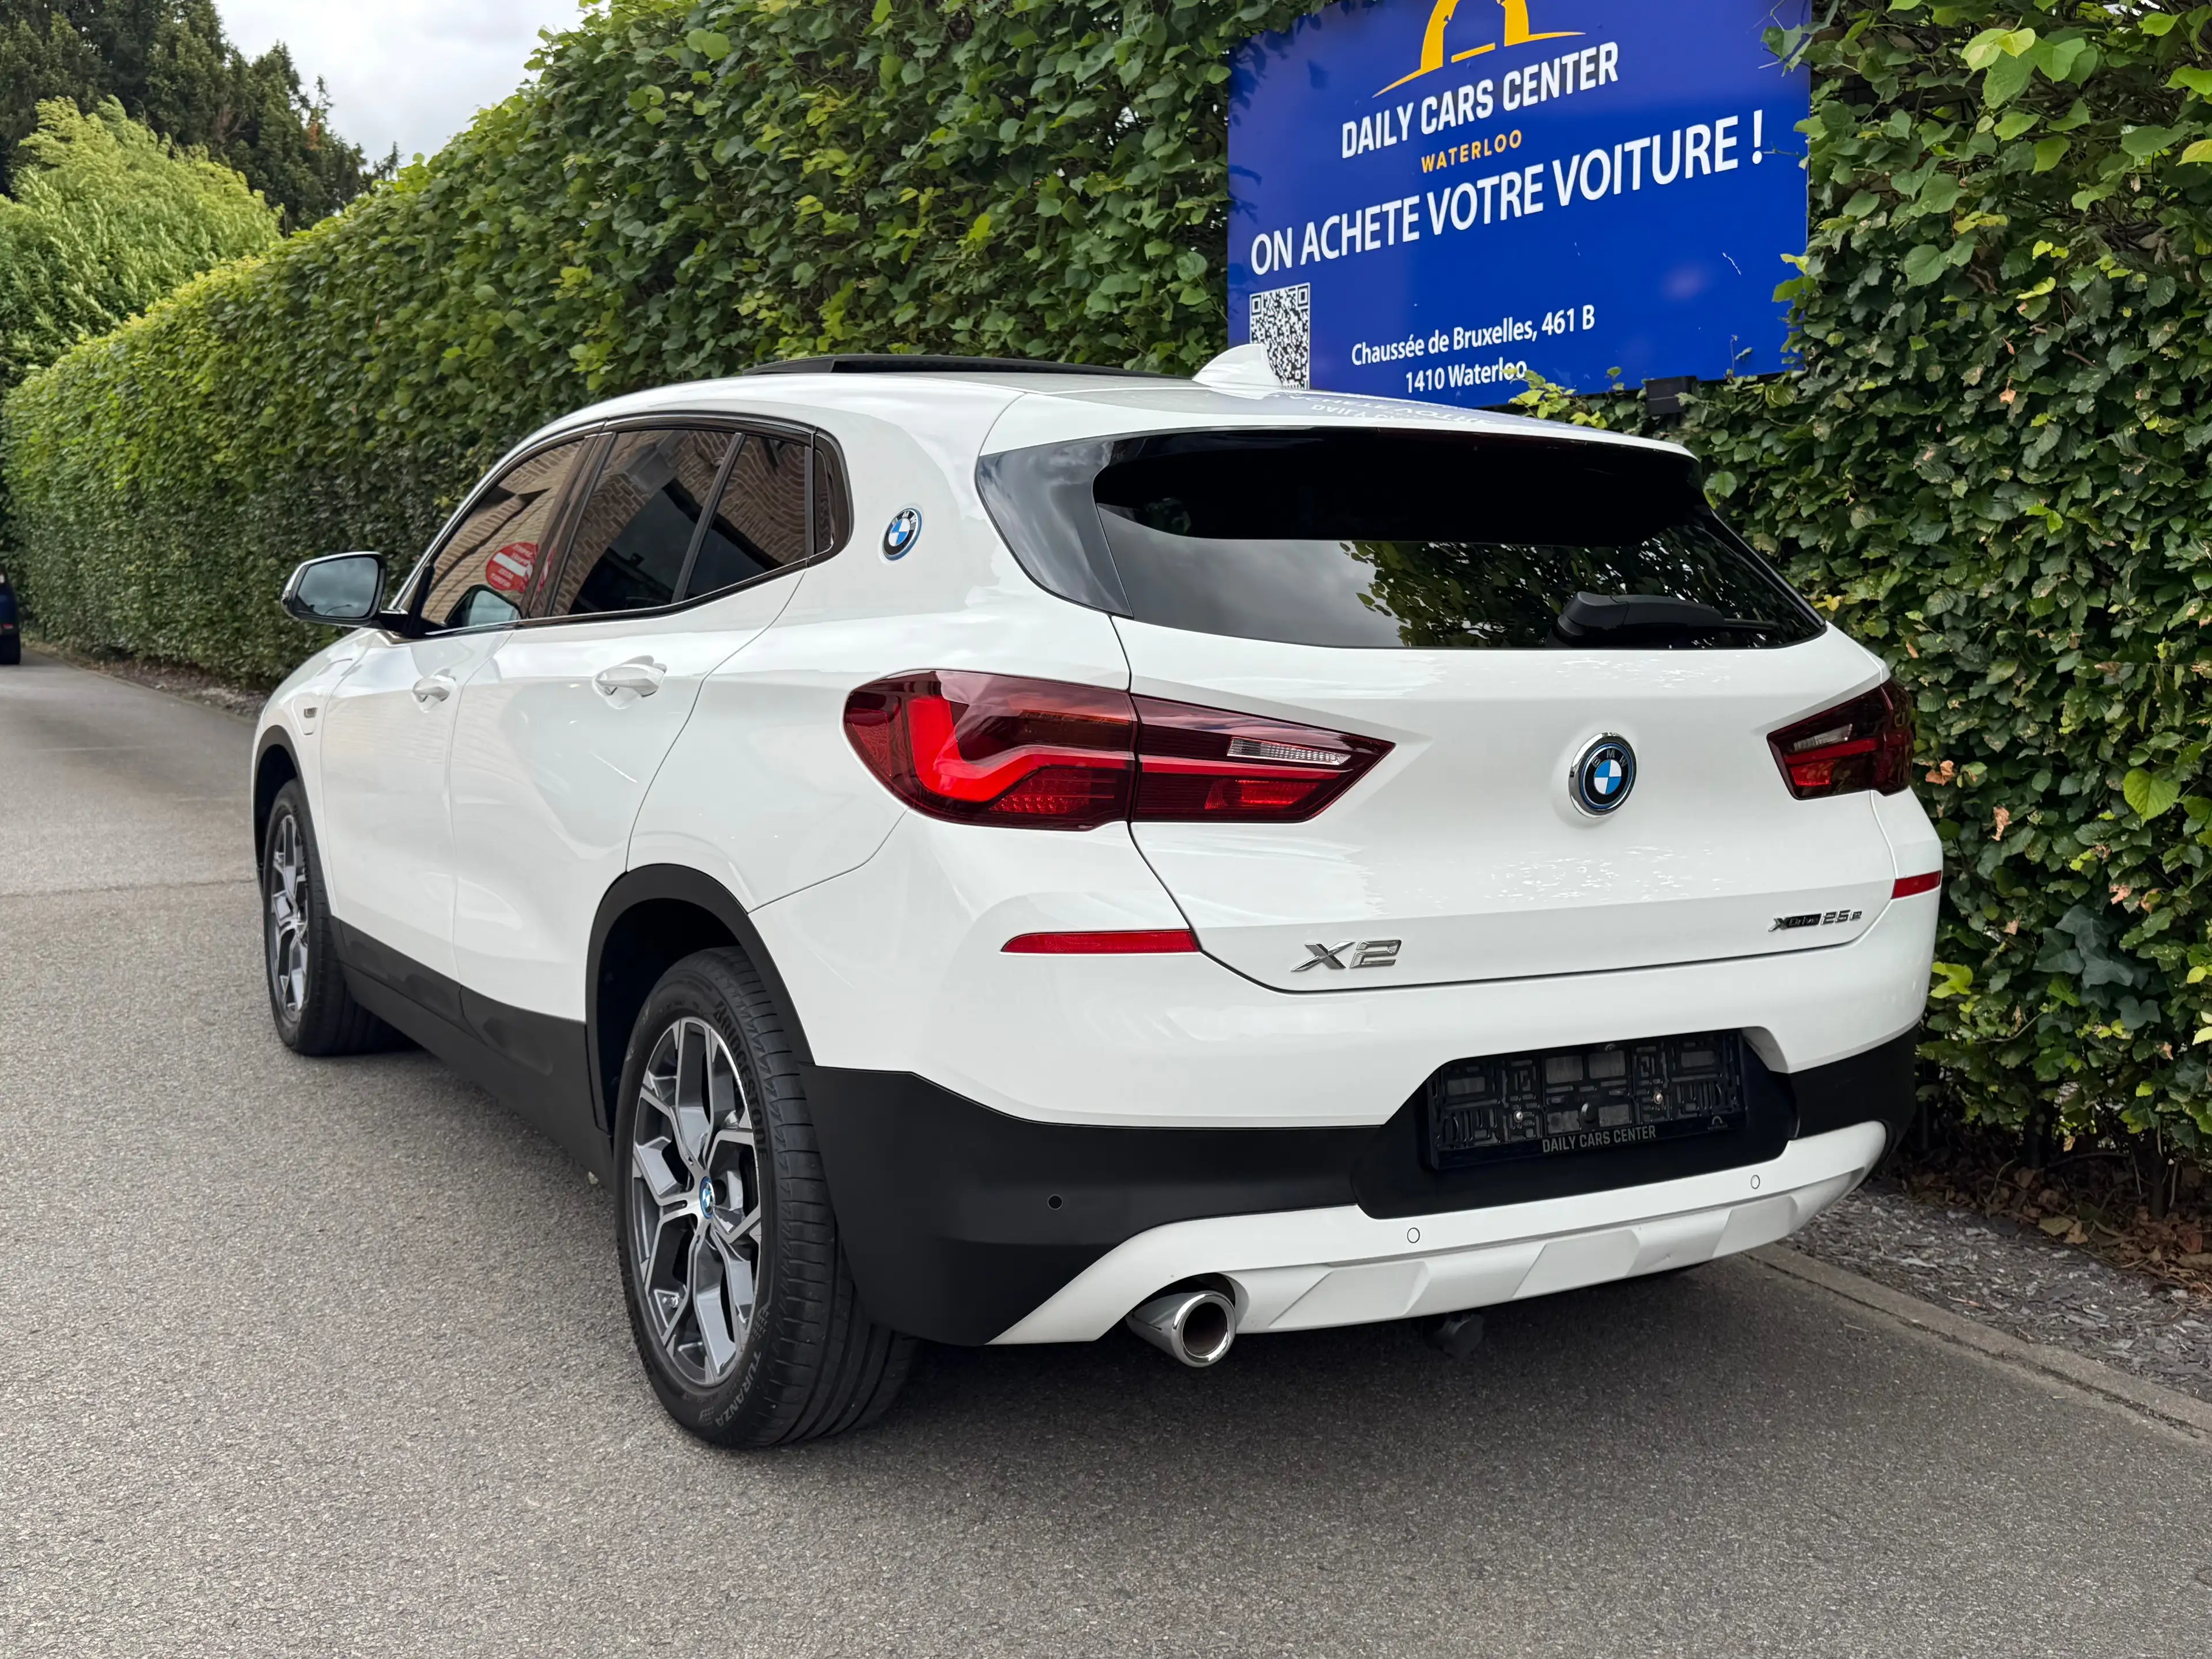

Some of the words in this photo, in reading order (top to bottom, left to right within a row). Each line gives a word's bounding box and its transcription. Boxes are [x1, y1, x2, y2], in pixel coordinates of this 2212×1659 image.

[1342, 102, 1414, 159] DAILY
[1420, 79, 1494, 135] CARS
[1502, 41, 1619, 112] CENTER
[1421, 129, 1522, 173] WATERLOO
[1251, 227, 1293, 275] ON
[1300, 195, 1421, 266] ACHETE
[1426, 163, 1544, 236] VOTRE
[1552, 115, 1739, 206] VOITURE
[1351, 332, 1425, 366] Chaussée
[1428, 329, 1449, 354] de
[1453, 317, 1538, 350] Bruxelles,
[1541, 308, 1575, 336] 461
[1582, 304, 1595, 330] B
[1406, 367, 1445, 393] 1410
[1448, 356, 1527, 388] Waterloo
[1590, 749, 1628, 768] BMW
[1290, 938, 1402, 972] X2
[713, 999, 770, 1162] BRIDGESTONE
[1542, 1135, 1576, 1153] DAILY
[1579, 1129, 1611, 1148] CARS
[1613, 1124, 1657, 1143] CENTER
[715, 1350, 762, 1428] TURANZA
